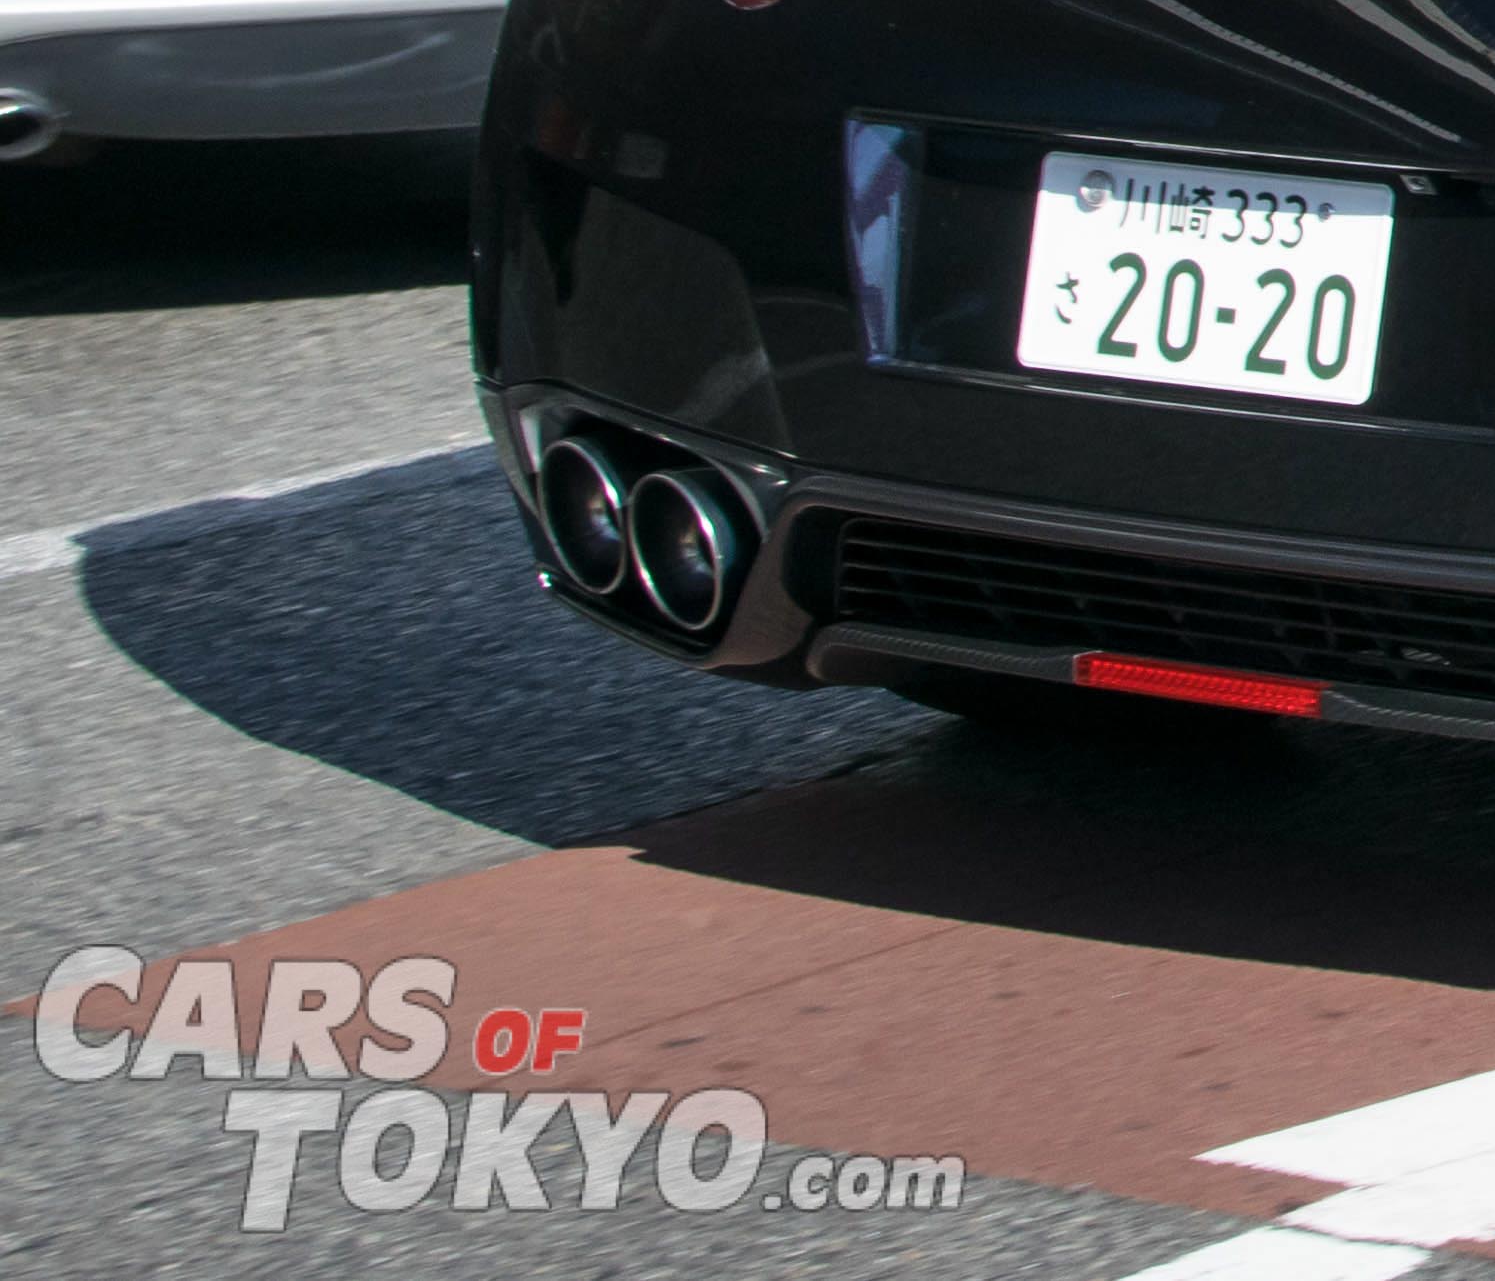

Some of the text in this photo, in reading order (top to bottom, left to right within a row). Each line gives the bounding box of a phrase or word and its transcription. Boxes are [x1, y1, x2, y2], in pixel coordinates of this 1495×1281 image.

[1120, 178, 1308, 249] 川崎 333
[1055, 252, 1357, 381] さ 20-20
